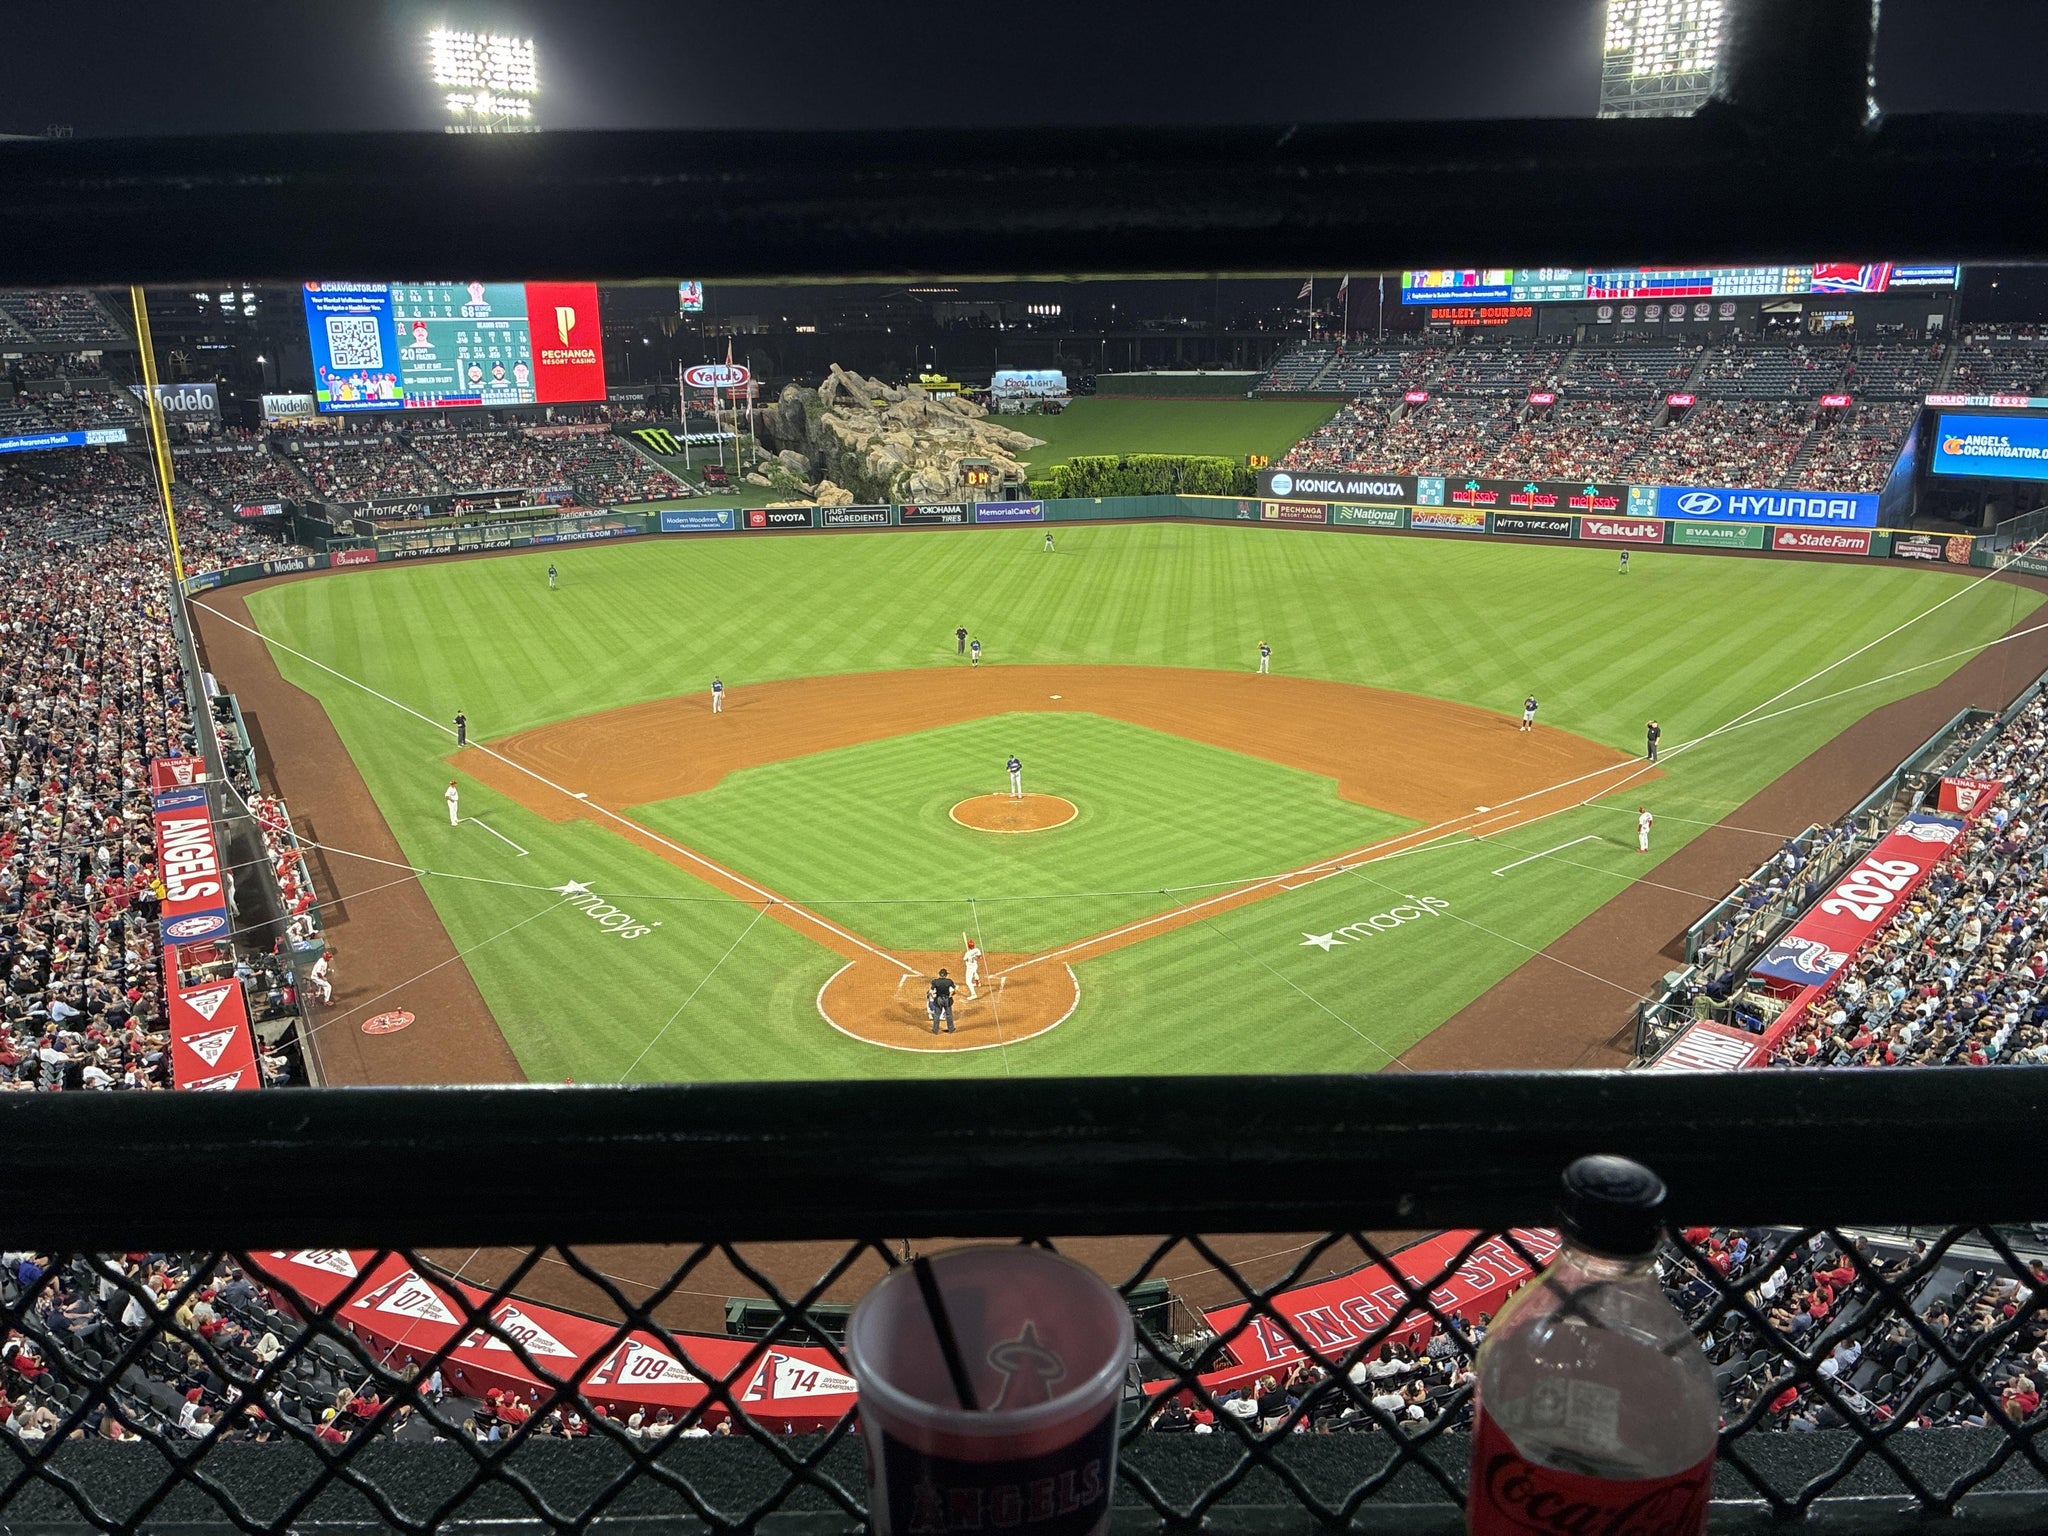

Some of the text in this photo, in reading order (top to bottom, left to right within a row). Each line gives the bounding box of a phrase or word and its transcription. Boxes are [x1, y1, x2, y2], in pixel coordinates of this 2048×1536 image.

[461, 306, 474, 317] 68
[1432, 307, 1532, 319] BULLEIT BOURBON
[1601, 308, 1609, 316] 11
[1623, 307, 1634, 316] 26
[1672, 306, 1683, 314] 30
[1696, 306, 1708, 314] 42
[1722, 304, 1734, 313] 50
[401, 349, 415, 360] 20
[542, 349, 595, 358] PECHANGA
[697, 372, 740, 382] Yakult
[1004, 378, 1029, 388] Coors
[270, 399, 308, 412] Modelo
[1964, 435, 2010, 447] ANGELS.
[968, 472, 987, 484] 0:14
[1296, 480, 1404, 496] KONICA MINOLTA
[240, 505, 262, 517] JMG
[979, 507, 1031, 516] MemorialCare
[1352, 506, 1397, 520] National
[1728, 496, 1856, 520] HYUNDAI
[769, 514, 805, 522] TOYOTA
[829, 513, 884, 522] INGREDIENTS
[1416, 512, 1457, 525] Surfside
[1497, 519, 1569, 531] NITTO TIRE.COM
[1587, 522, 1658, 538] Yakult
[556, 530, 610, 541] 714TICKETS.COM
[482, 540, 511, 549] TIRE.COM
[419, 546, 450, 556] TIRE.COM
[274, 560, 304, 573] Modelo
[1944, 778, 1976, 788] SALINAS,
[160, 818, 220, 902] ANGELS
[1821, 858, 1920, 922] 2026
[393, 1287, 429, 1307] '07
[1250, 1276, 1459, 1362] ANGEL
[528, 1341, 556, 1353] CHAMPIONS
[534, 1336, 556, 1346] DIVISION
[631, 1356, 669, 1379] '09
[663, 1371, 694, 1382] CHAMPIONS
[787, 1369, 820, 1391] '14
[820, 1383, 855, 1391] CHAMPIONS
[908, 1459, 1102, 1534] ANGELS
